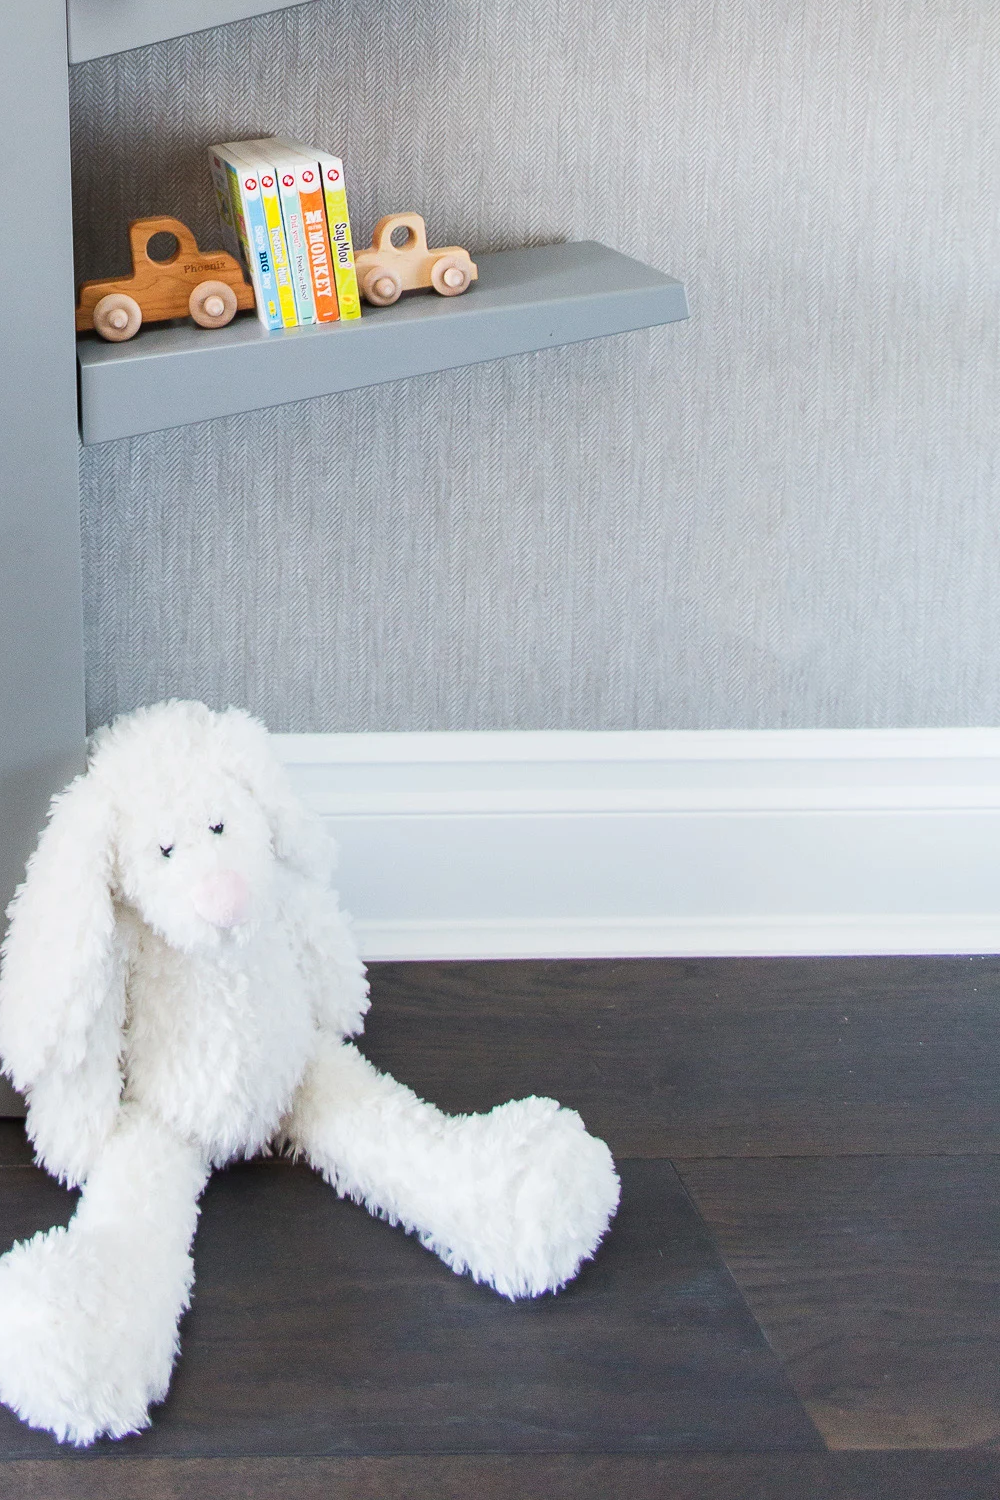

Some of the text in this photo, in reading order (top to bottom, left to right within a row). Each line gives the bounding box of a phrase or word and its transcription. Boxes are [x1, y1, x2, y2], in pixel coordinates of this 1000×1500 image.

[304, 209, 323, 225] M
[258, 251, 270, 273] BIG
[270, 225, 289, 286] Treasure Hunt
[290, 214, 299, 229] Did
[296, 254, 309, 301] Peek-a-Boo!
[333, 222, 352, 269] Say Moo?
[183, 260, 226, 274] Phoenix
[262, 272, 272, 290] Day
[308, 230, 333, 298] MONKEY
